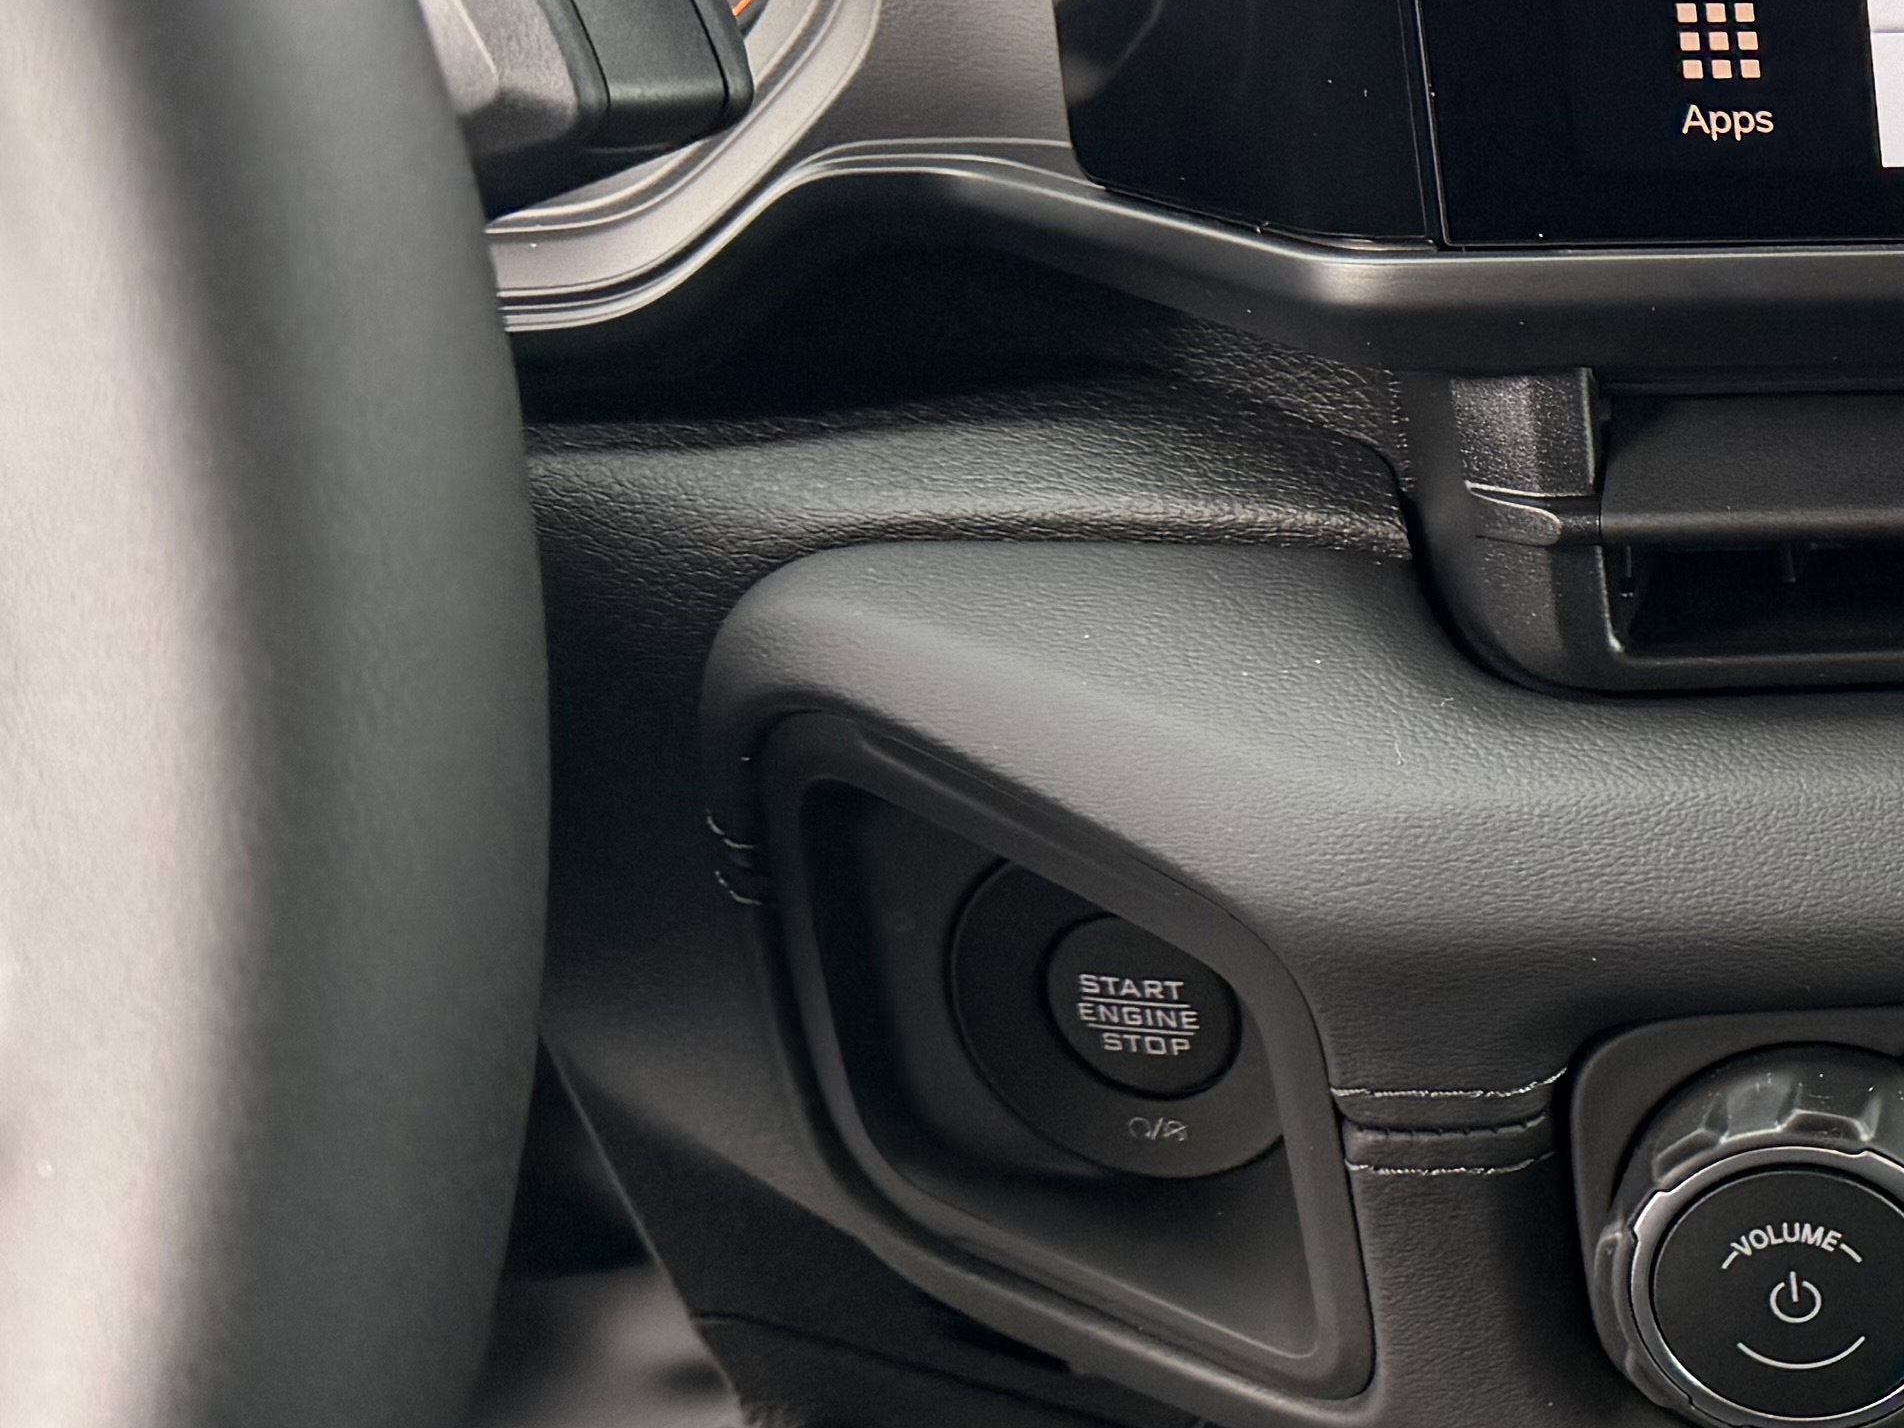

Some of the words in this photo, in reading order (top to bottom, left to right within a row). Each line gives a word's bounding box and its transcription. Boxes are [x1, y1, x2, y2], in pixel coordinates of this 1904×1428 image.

[1682, 104, 1774, 141] Apps
[1080, 974, 1184, 1001] START
[1077, 1002, 1199, 1030] ENGINE
[1102, 1032, 1191, 1056] STOP
[1731, 1222, 1841, 1256] VOLUME
